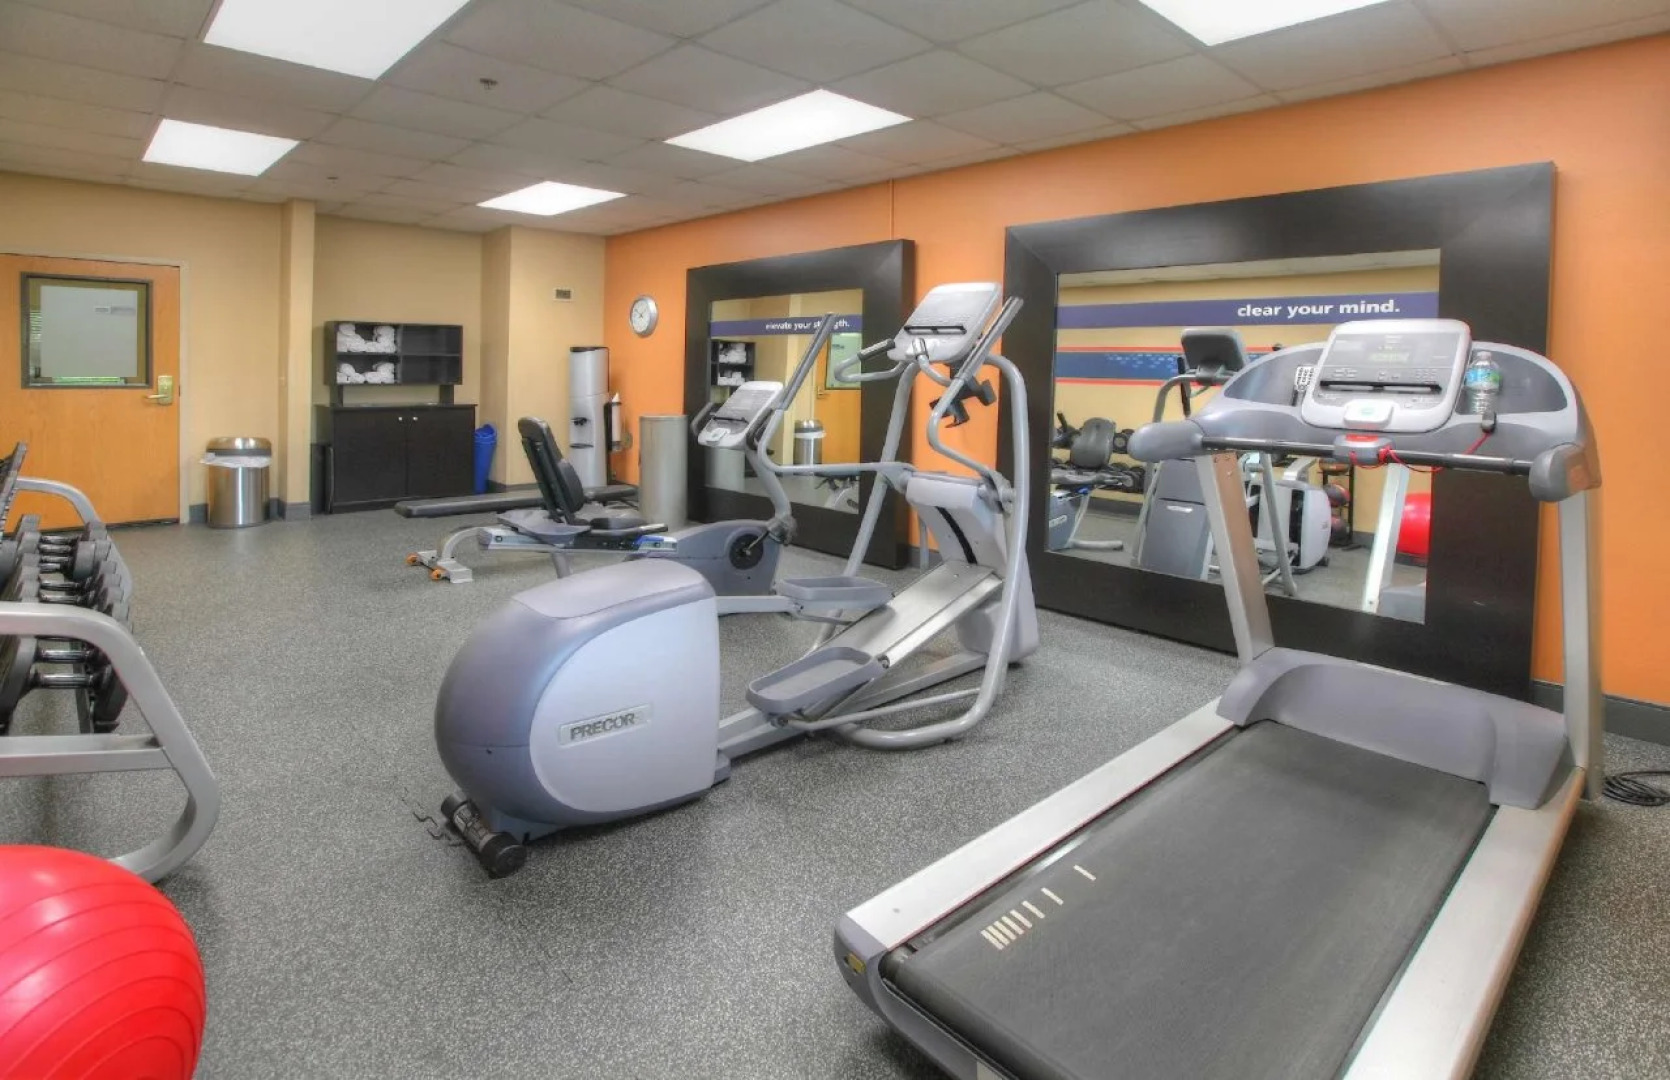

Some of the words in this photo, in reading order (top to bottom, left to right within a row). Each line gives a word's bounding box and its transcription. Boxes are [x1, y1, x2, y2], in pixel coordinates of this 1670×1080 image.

[1237, 304, 1282, 317] clear
[1287, 304, 1334, 319] your
[1339, 299, 1400, 314] mind.
[794, 322, 812, 331] your
[813, 318, 850, 330] stgth.
[570, 713, 635, 741] PRECOR
